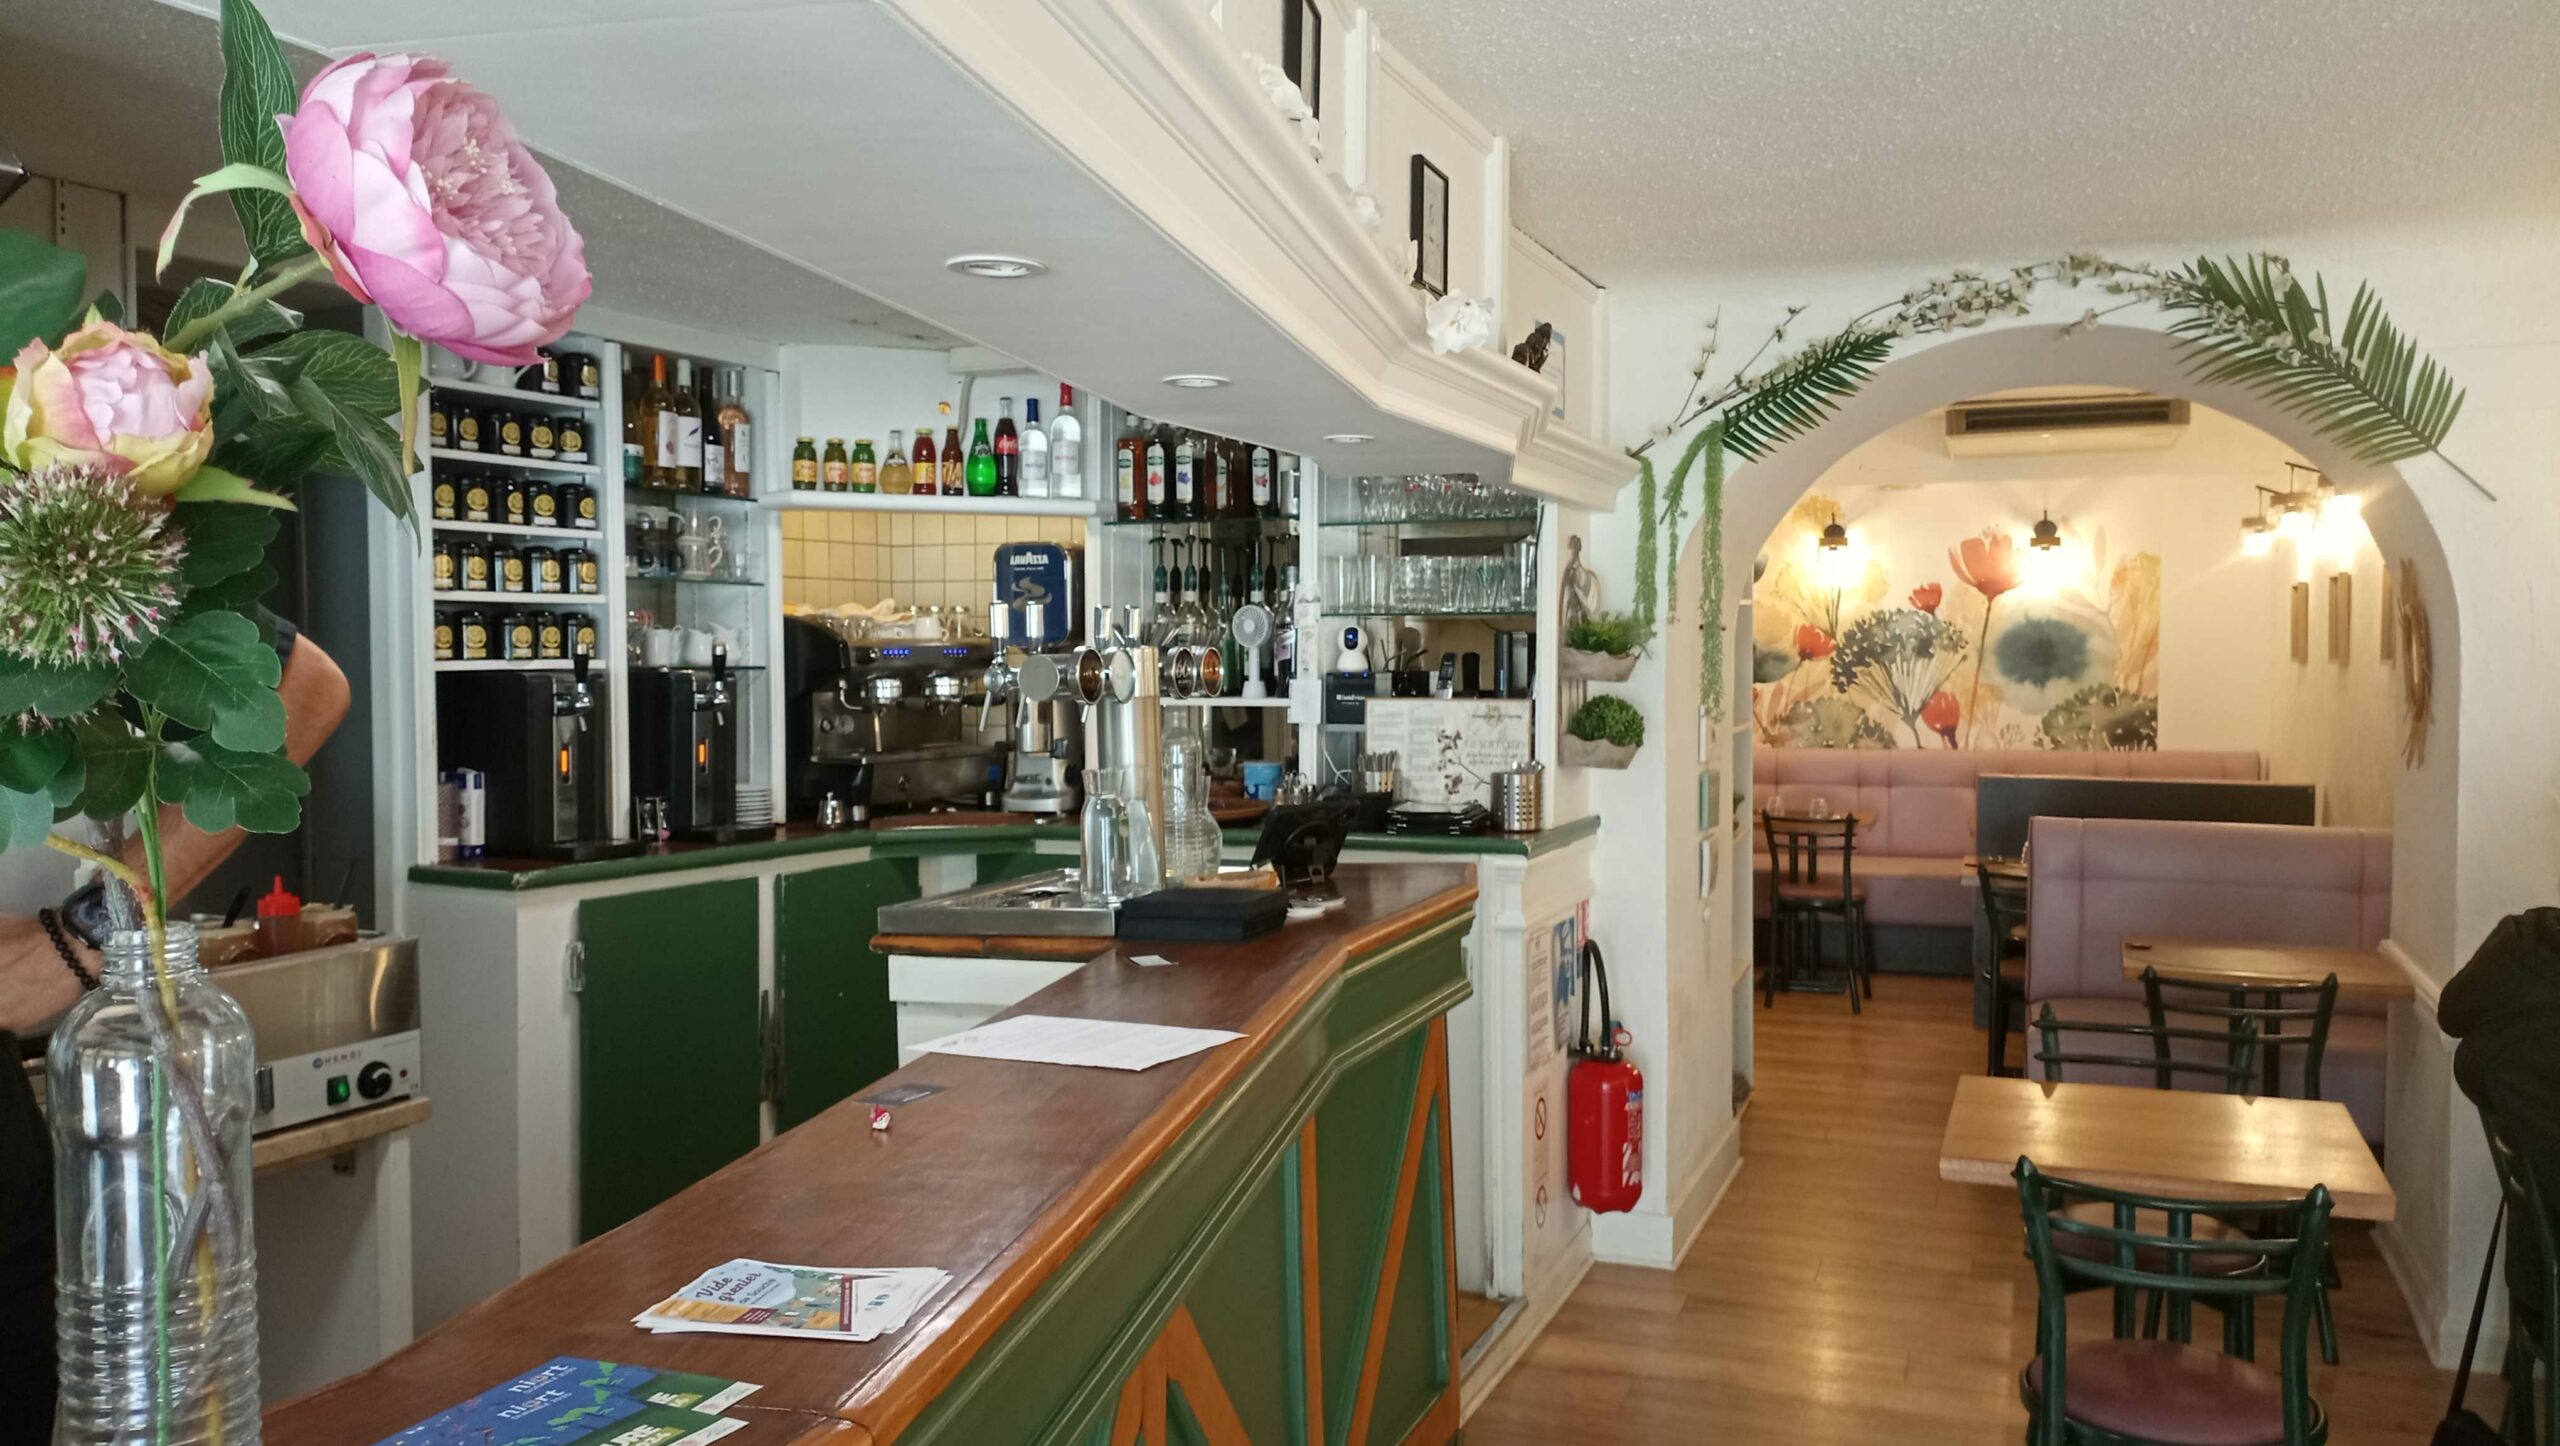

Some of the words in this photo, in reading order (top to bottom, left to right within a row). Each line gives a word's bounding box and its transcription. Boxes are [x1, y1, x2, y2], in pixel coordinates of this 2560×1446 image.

[1009, 551, 1049, 566] LAVAZZA
[695, 1276, 733, 1298] Vide
[718, 1271, 762, 1302] grenier
[507, 1364, 569, 1393] niort
[496, 1388, 565, 1418] niort
